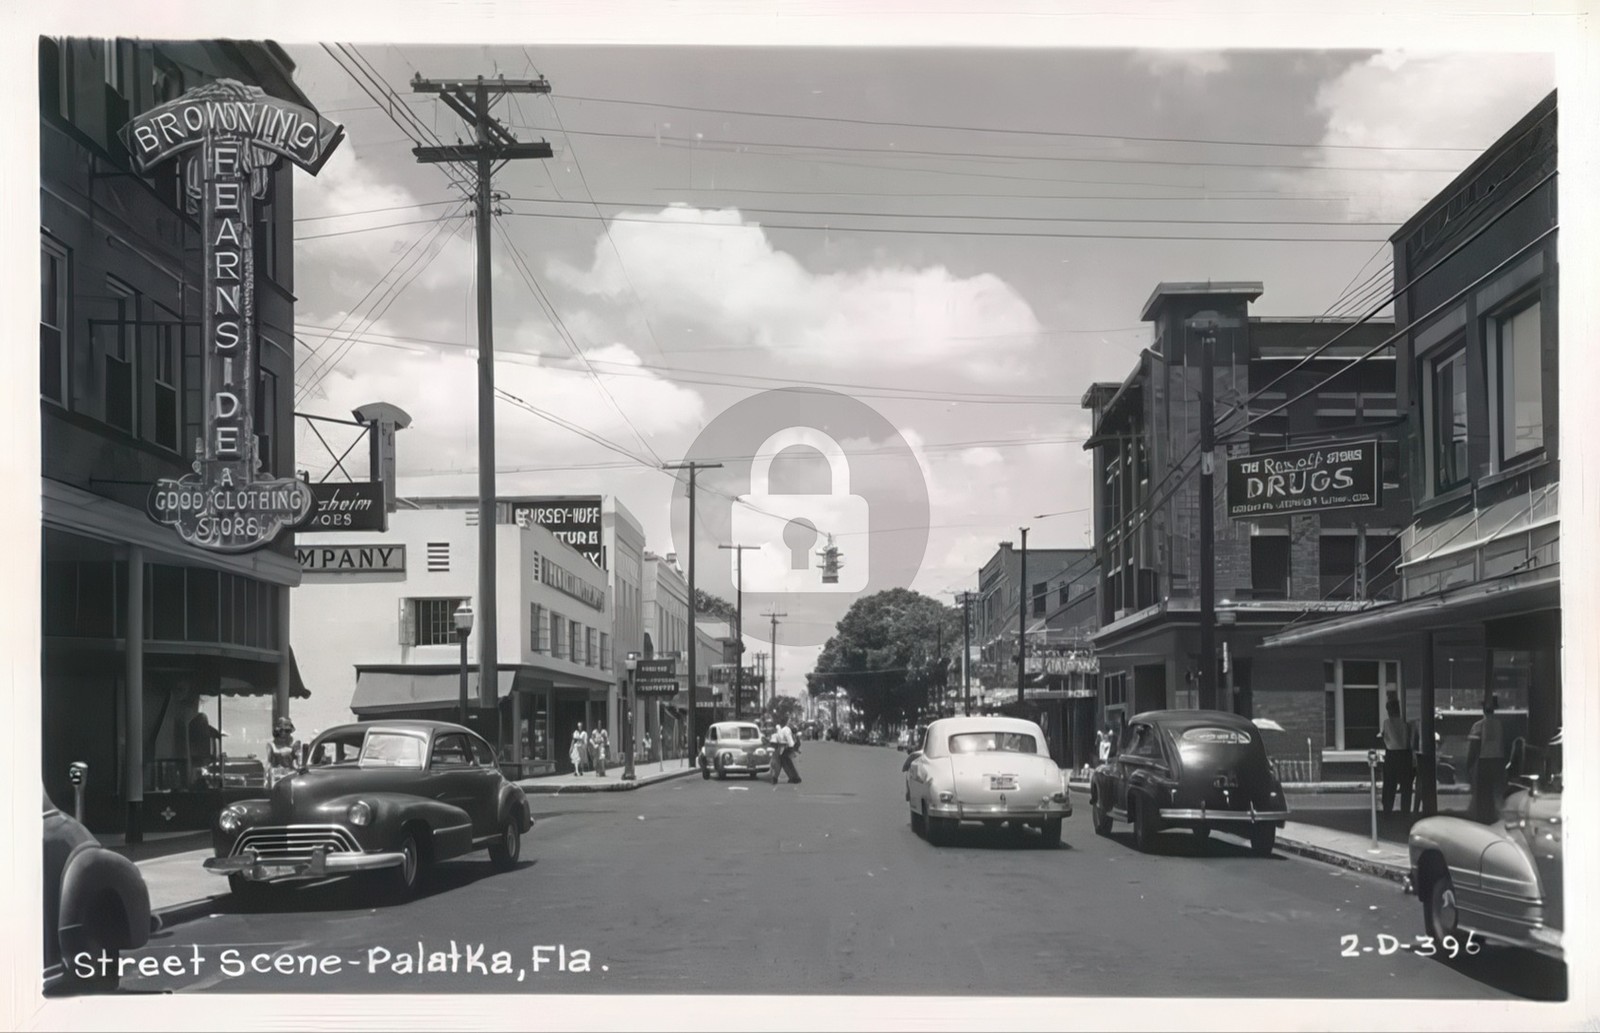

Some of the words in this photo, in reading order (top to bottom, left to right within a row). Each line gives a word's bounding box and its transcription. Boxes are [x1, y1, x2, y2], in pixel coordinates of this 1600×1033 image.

[134, 101, 318, 153] BROWNING
[1247, 467, 1354, 499] DRUGS
[213, 490, 301, 511] CLOTHING
